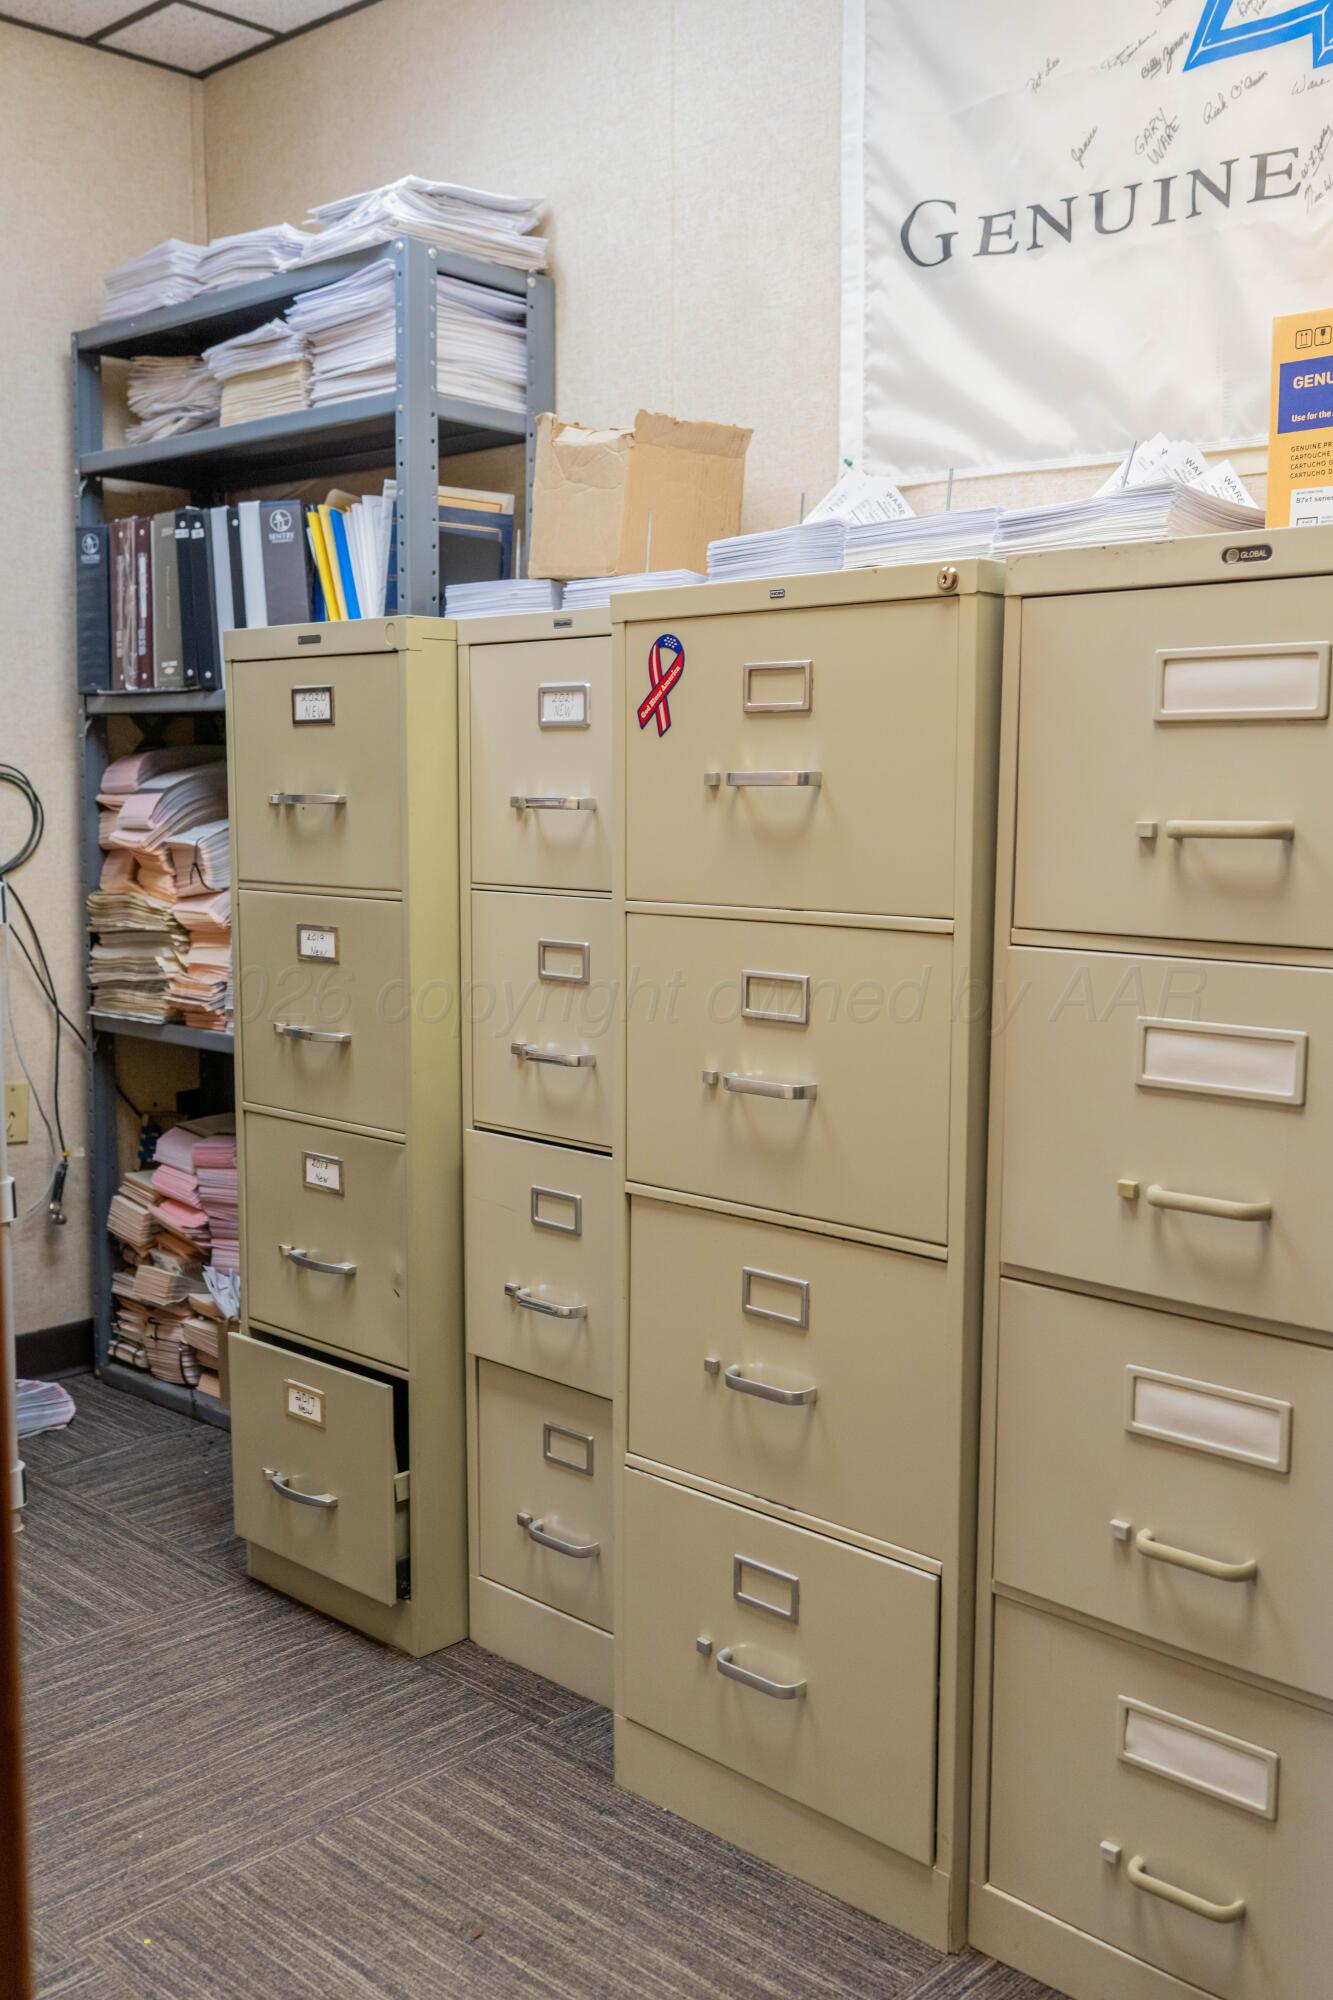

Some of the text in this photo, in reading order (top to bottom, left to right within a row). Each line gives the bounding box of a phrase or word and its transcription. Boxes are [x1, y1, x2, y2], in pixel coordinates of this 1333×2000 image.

[1134, 107, 1171, 155] GARY
[1291, 410, 1332, 423] Use for the
[1290, 443, 1322, 453] GENUINE
[1290, 450, 1331, 461] CARTOUCHE
[1290, 460, 1327, 470] CARTUCHO
[1290, 469, 1326, 479] CARTUCHO
[1224, 475, 1246, 504] WARE
[1240, 550, 1267, 559] GLOBAL
[641, 665, 681, 719] God Bless America
[304, 703, 328, 719] NEW
